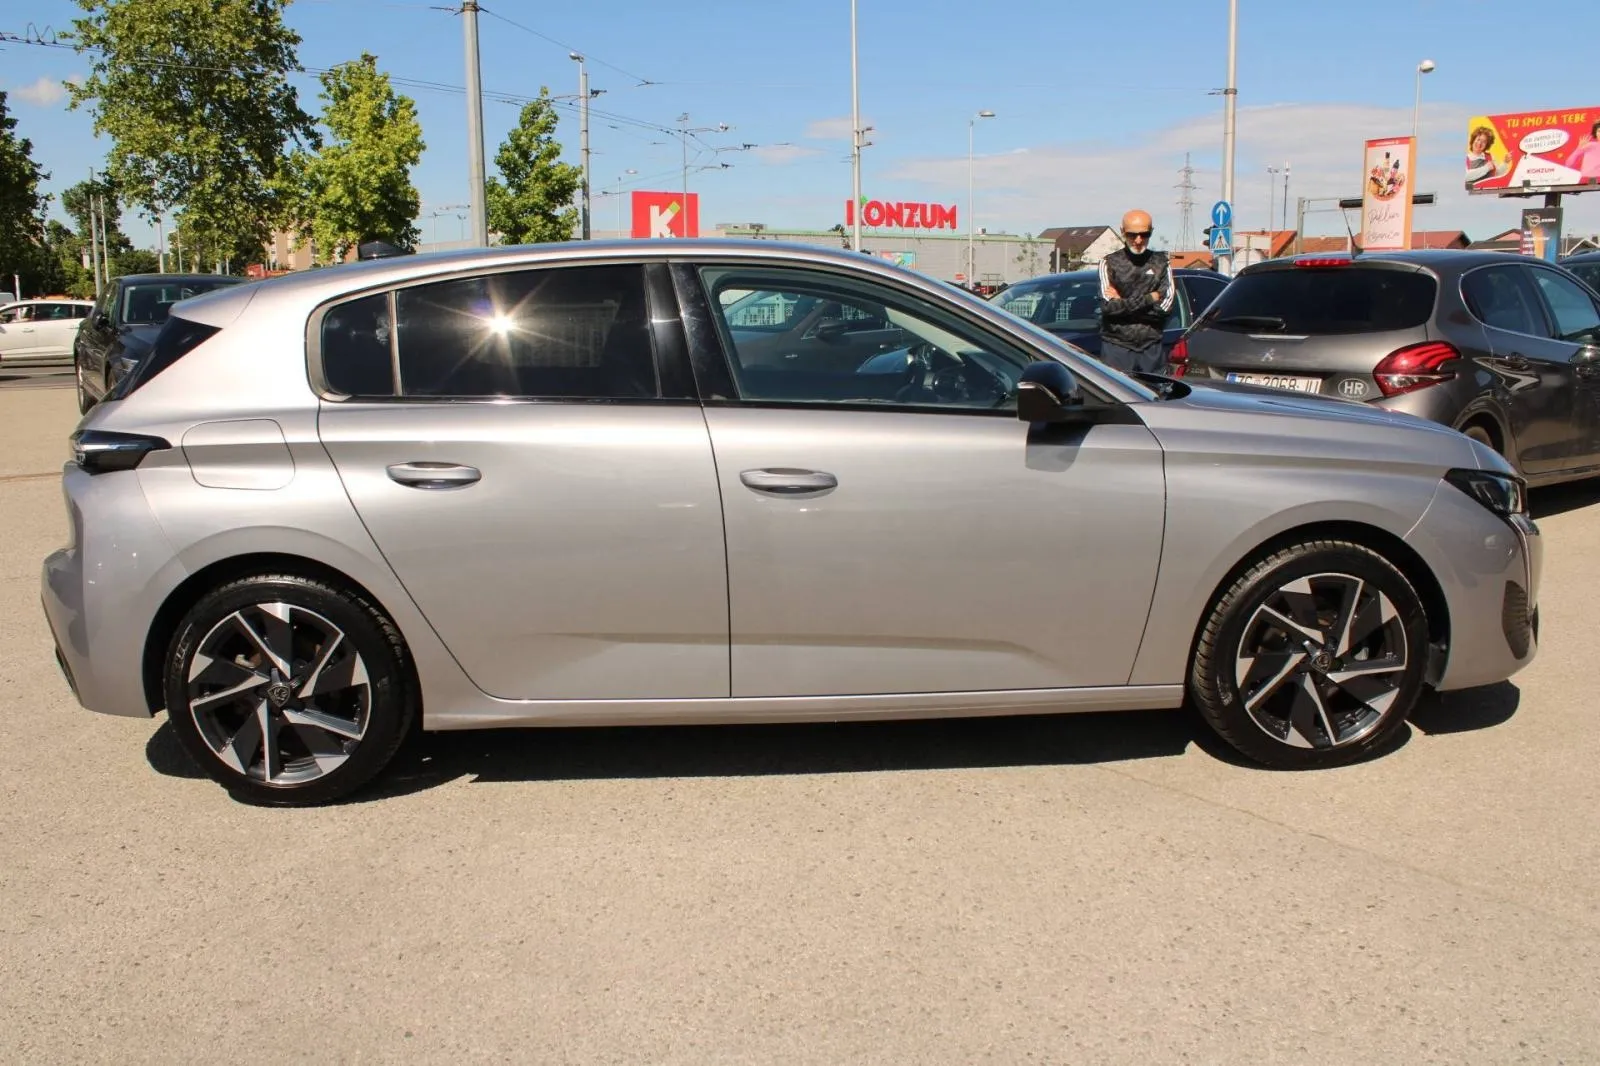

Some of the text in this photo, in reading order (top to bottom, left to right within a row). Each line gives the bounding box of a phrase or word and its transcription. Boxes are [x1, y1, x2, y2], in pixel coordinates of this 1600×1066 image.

[1507, 118, 1519, 128] TU
[1546, 114, 1558, 125] ZA
[1562, 112, 1587, 124] TEBE
[1344, 382, 1363, 395] HR
